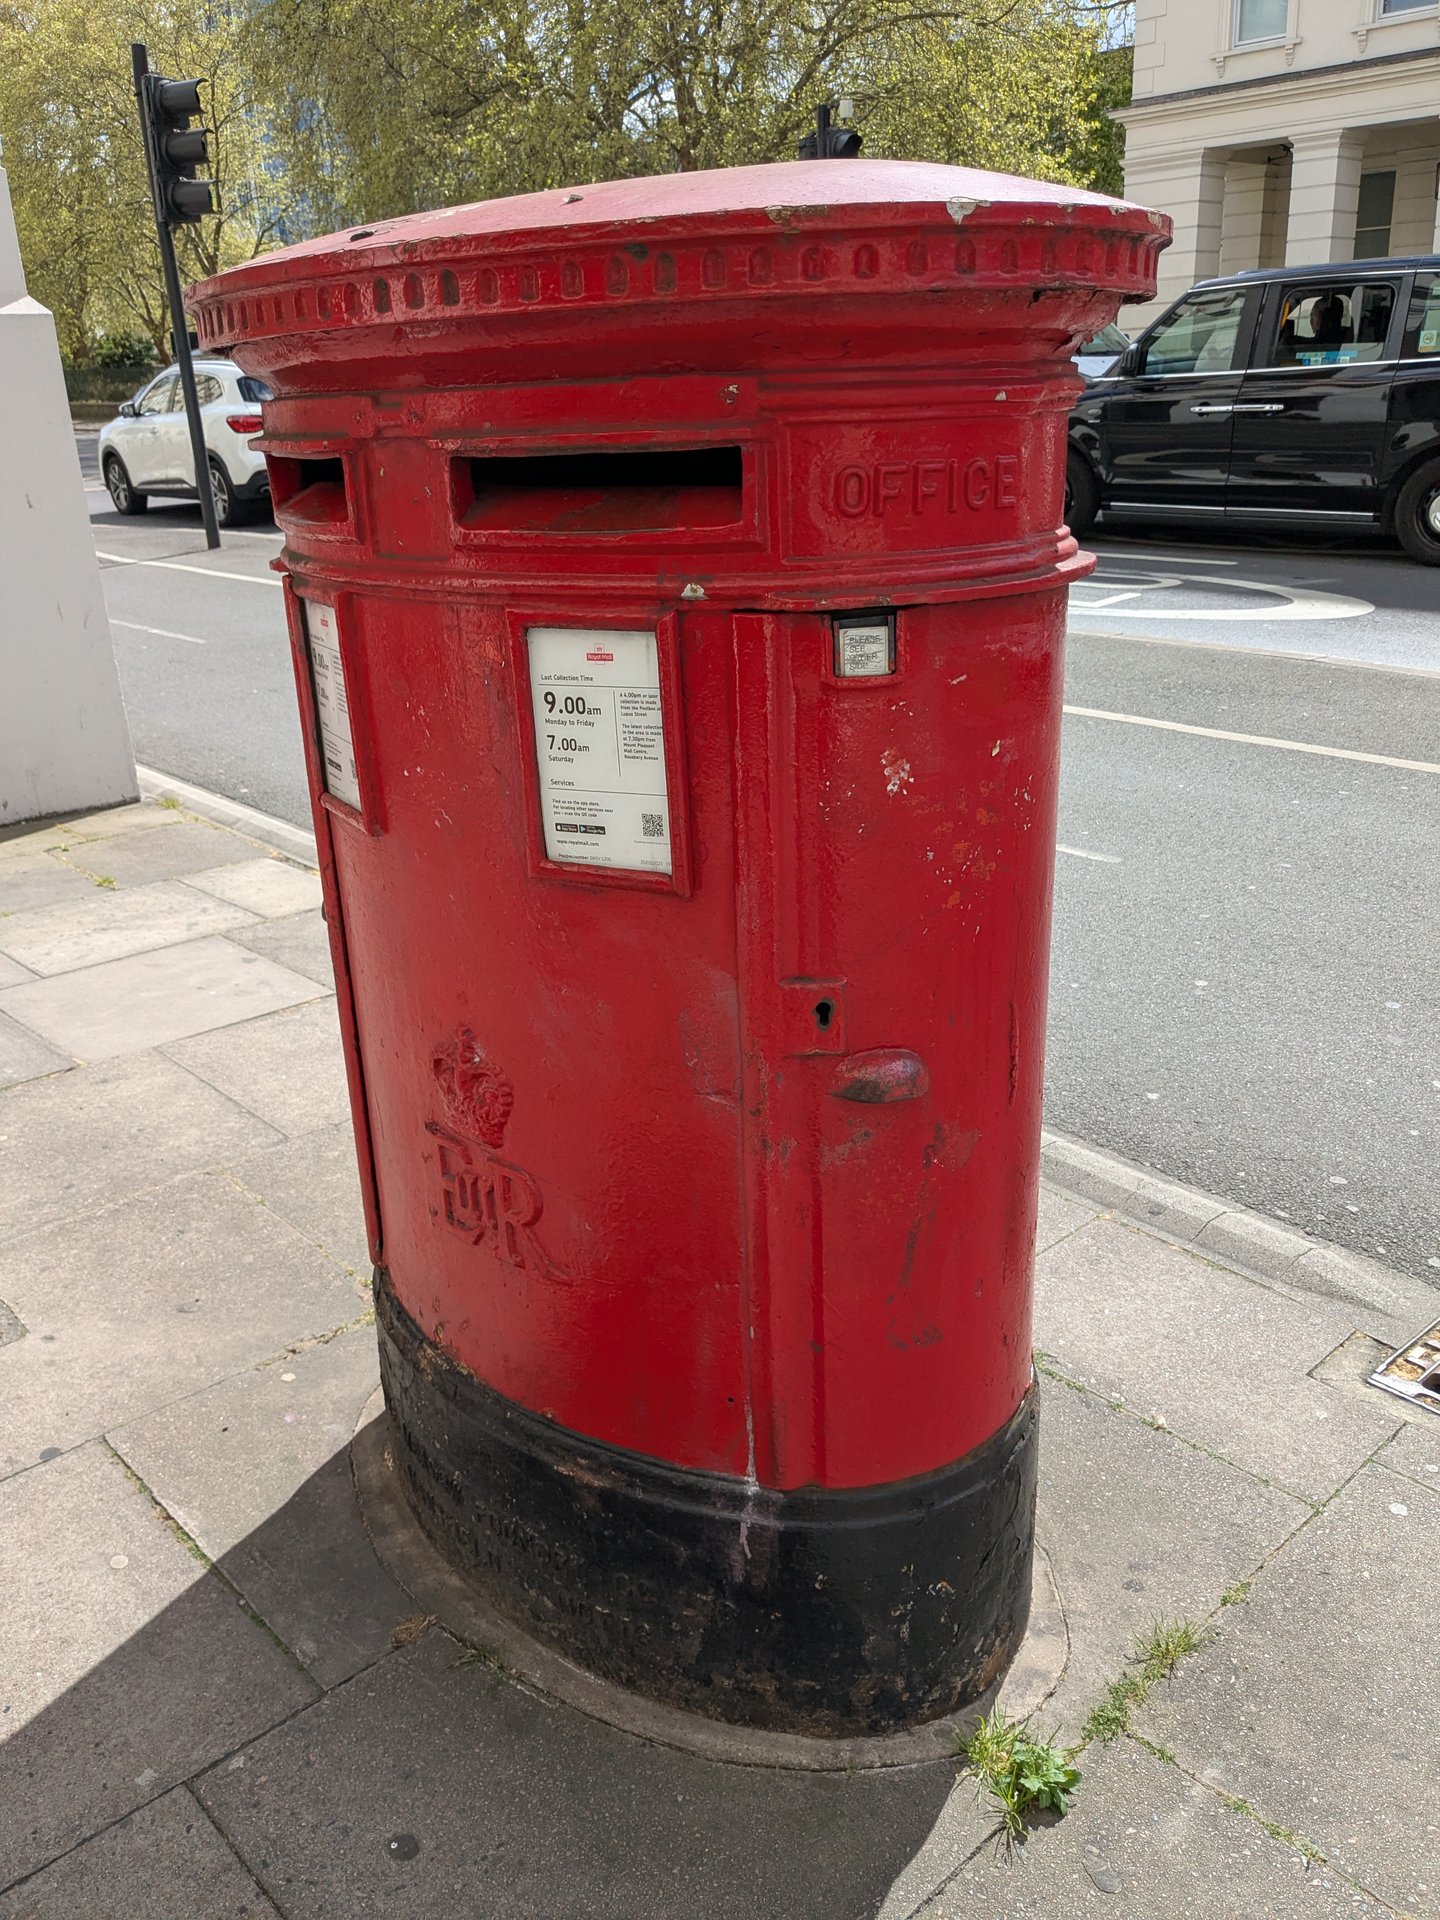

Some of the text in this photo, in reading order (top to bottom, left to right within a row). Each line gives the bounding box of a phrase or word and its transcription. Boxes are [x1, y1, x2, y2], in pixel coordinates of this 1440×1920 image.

[833, 455, 1018, 518] OFFICE
[544, 691, 602, 715] 9.00am
[545, 718, 568, 726] Monday
[577, 718, 595, 728] Friday
[547, 735, 590, 752] 7.00am
[549, 755, 574, 763] Saturday
[551, 778, 575, 786] Services
